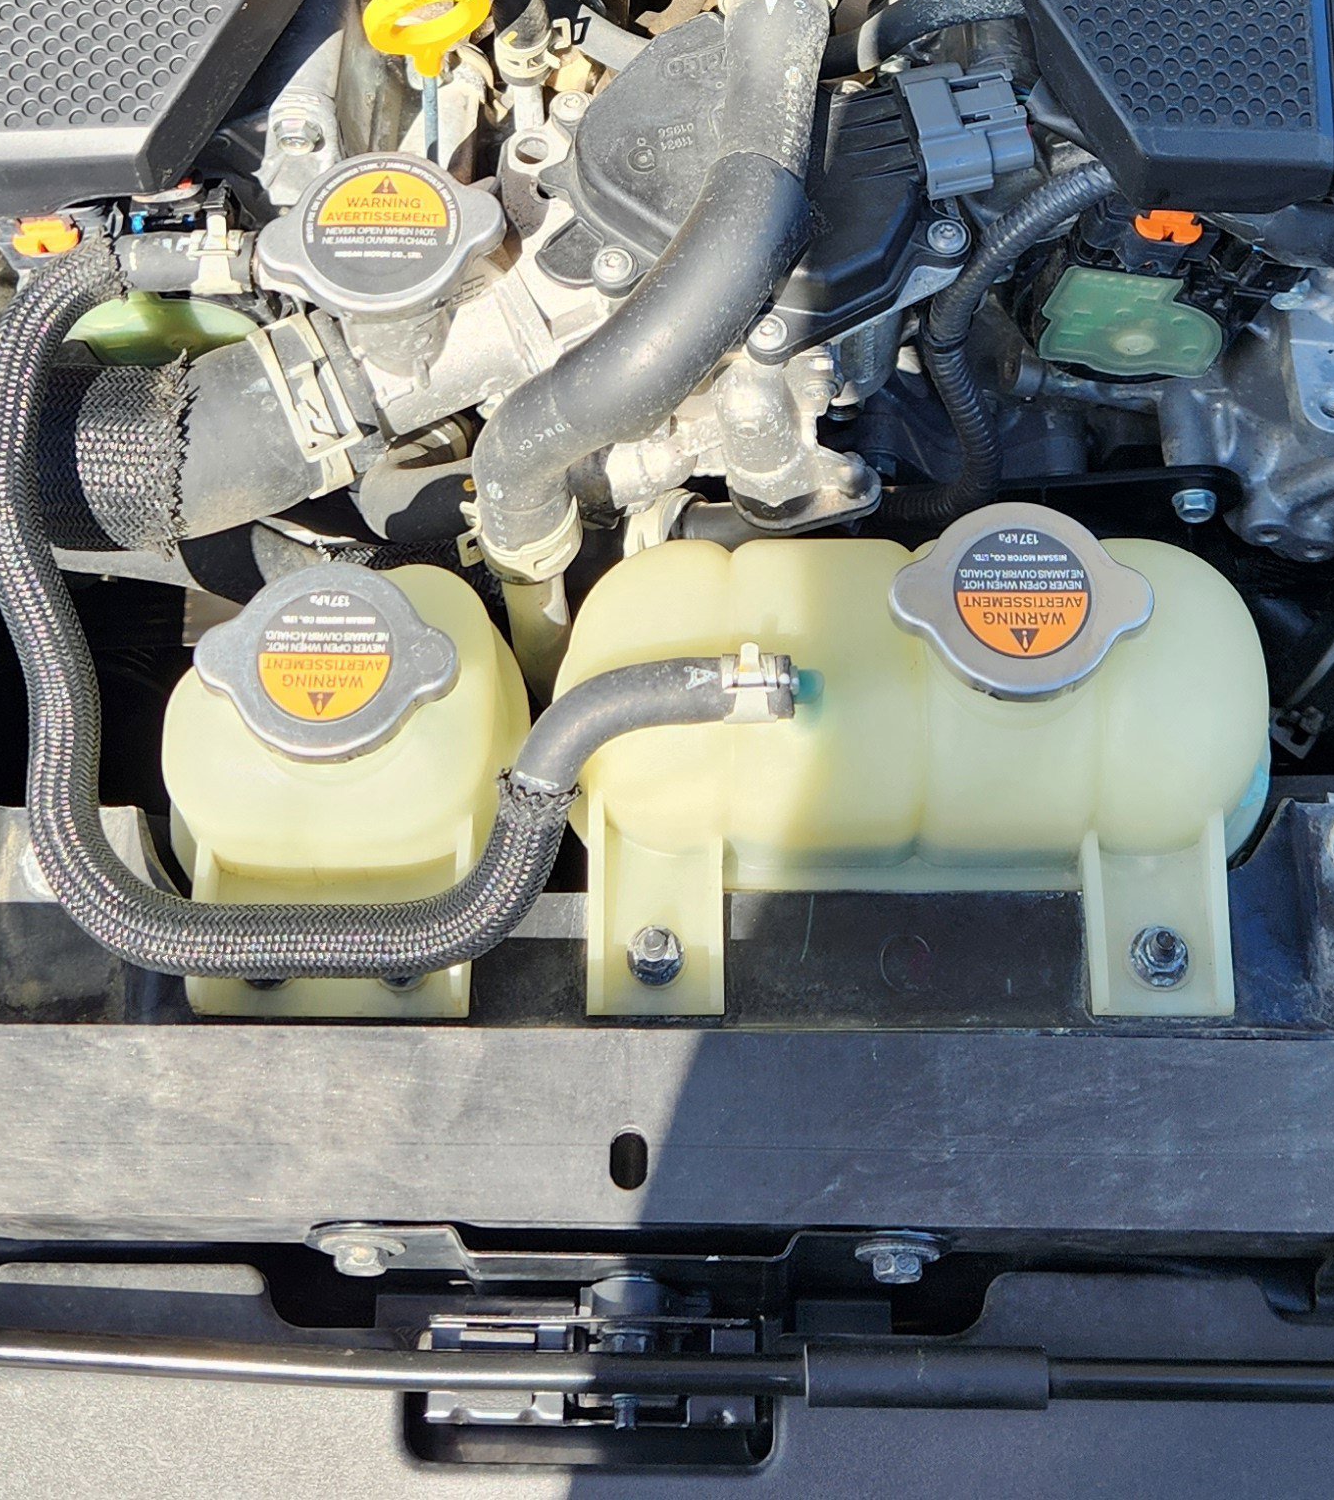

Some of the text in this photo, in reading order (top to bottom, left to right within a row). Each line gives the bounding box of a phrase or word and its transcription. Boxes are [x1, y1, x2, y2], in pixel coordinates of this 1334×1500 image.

[347, 197, 421, 208] WARNING
[326, 211, 439, 223] AVERTISSEMENT
[325, 227, 355, 235] NEVER
[998, 532, 1039, 545] 137 kPa
[1007, 554, 1036, 562] MOTOR
[1037, 554, 1068, 562] NISSAN
[962, 579, 1083, 590] NEVER OPEN WHEN HOT.
[963, 595, 1083, 608] AVERTISSEMENT
[982, 611, 1066, 625] WARNING
[292, 642, 322, 652] WHEN
[323, 642, 351, 653] OPEN
[353, 642, 385, 653] NEVER
[263, 658, 384, 670] AVERTISSEMENT
[281, 673, 363, 689] WARNING
